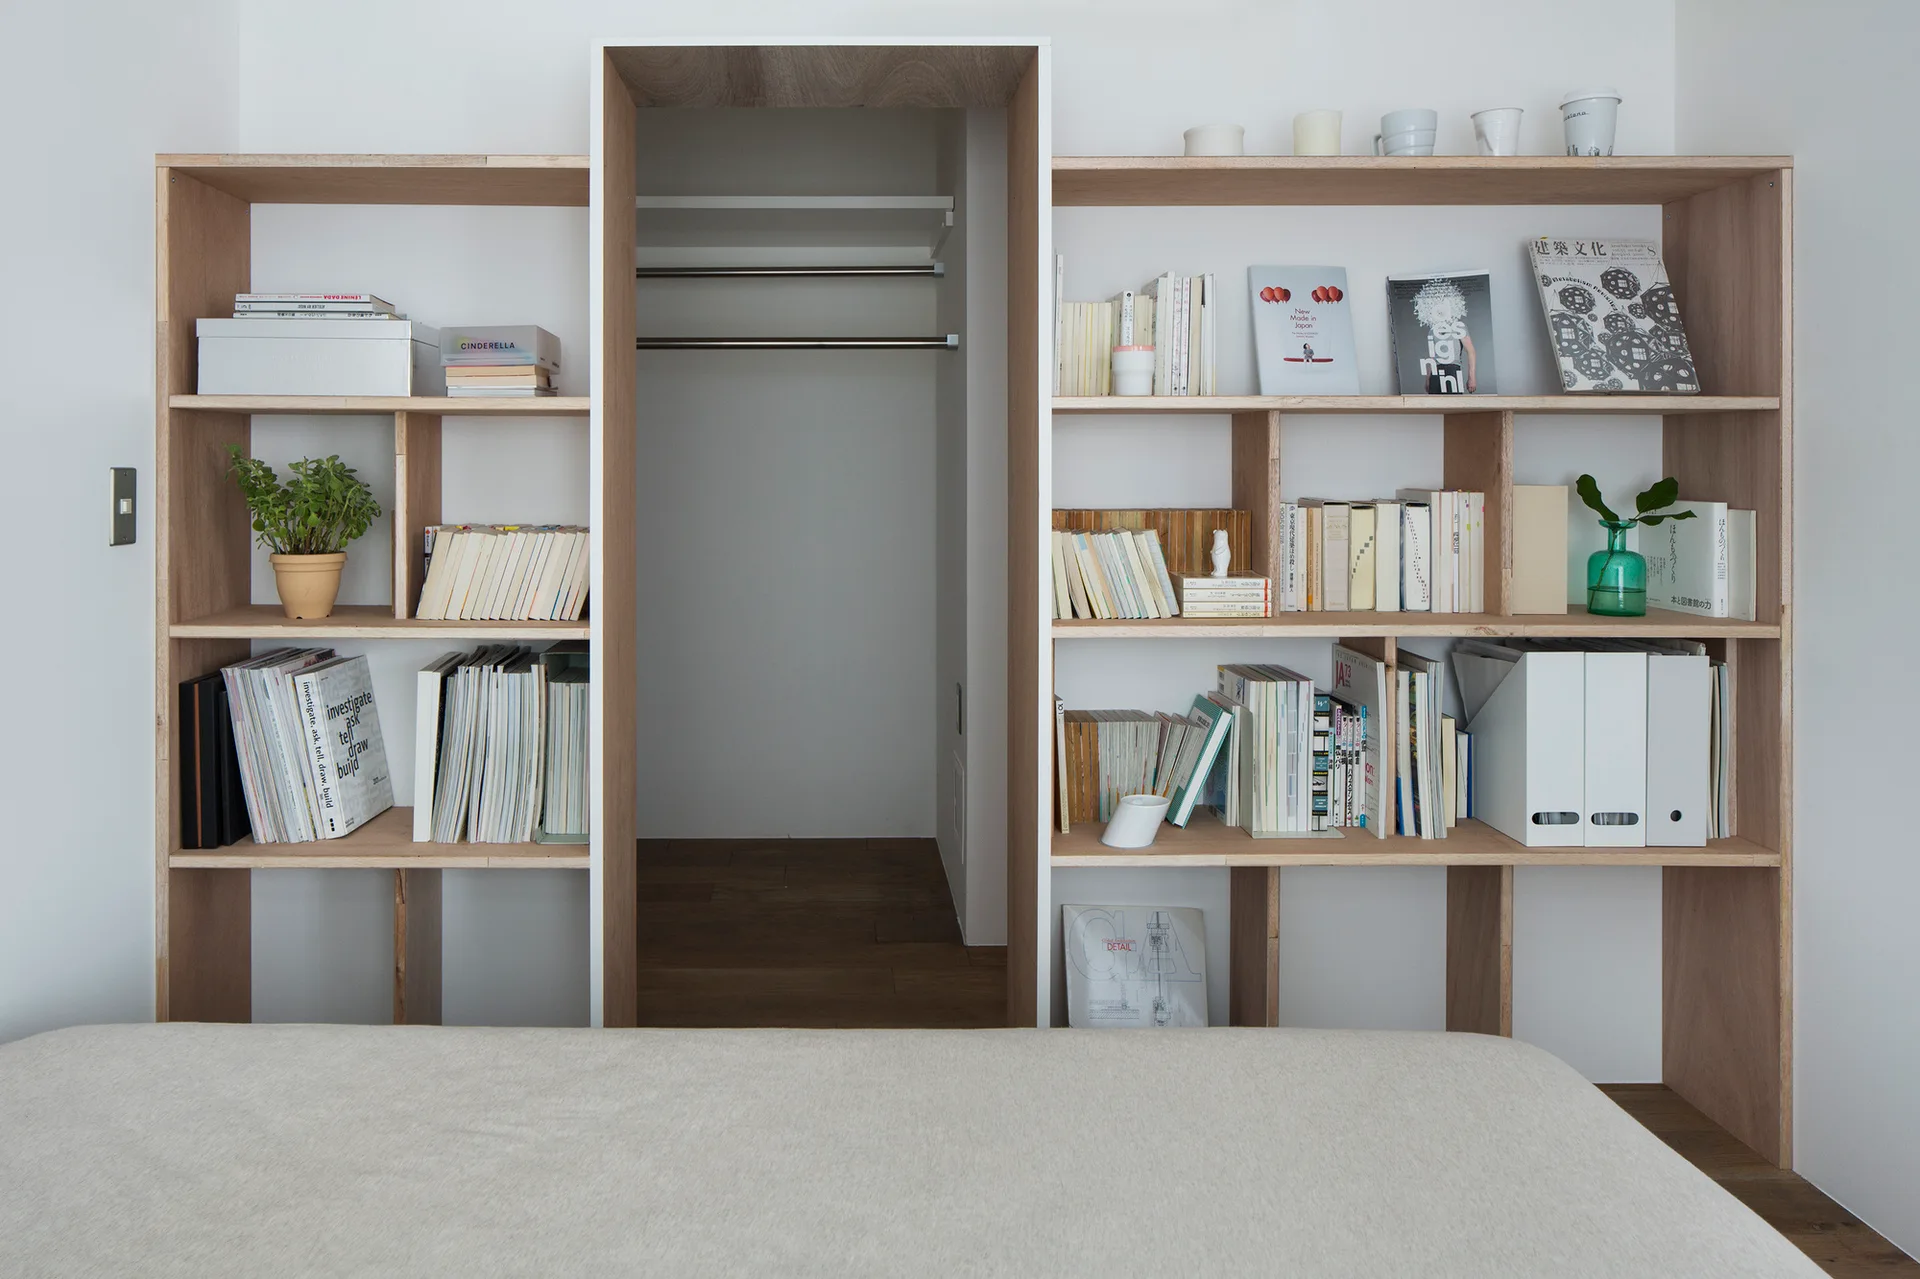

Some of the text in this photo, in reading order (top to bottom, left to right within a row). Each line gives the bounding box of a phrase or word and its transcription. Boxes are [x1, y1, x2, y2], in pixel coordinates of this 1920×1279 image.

[1535, 241, 1607, 256] 建築文化
[1294, 322, 1313, 330] Japan
[460, 342, 516, 350] CINDERELLA
[1670, 594, 1712, 610] 本と図書館の力
[1345, 663, 1352, 678] 73
[326, 690, 373, 721] investigate
[346, 712, 361, 728] ask
[339, 725, 355, 747] tell
[348, 737, 369, 759] draw
[336, 757, 360, 780] build
[322, 787, 334, 809] build
[1107, 942, 1132, 952] DETAIL
